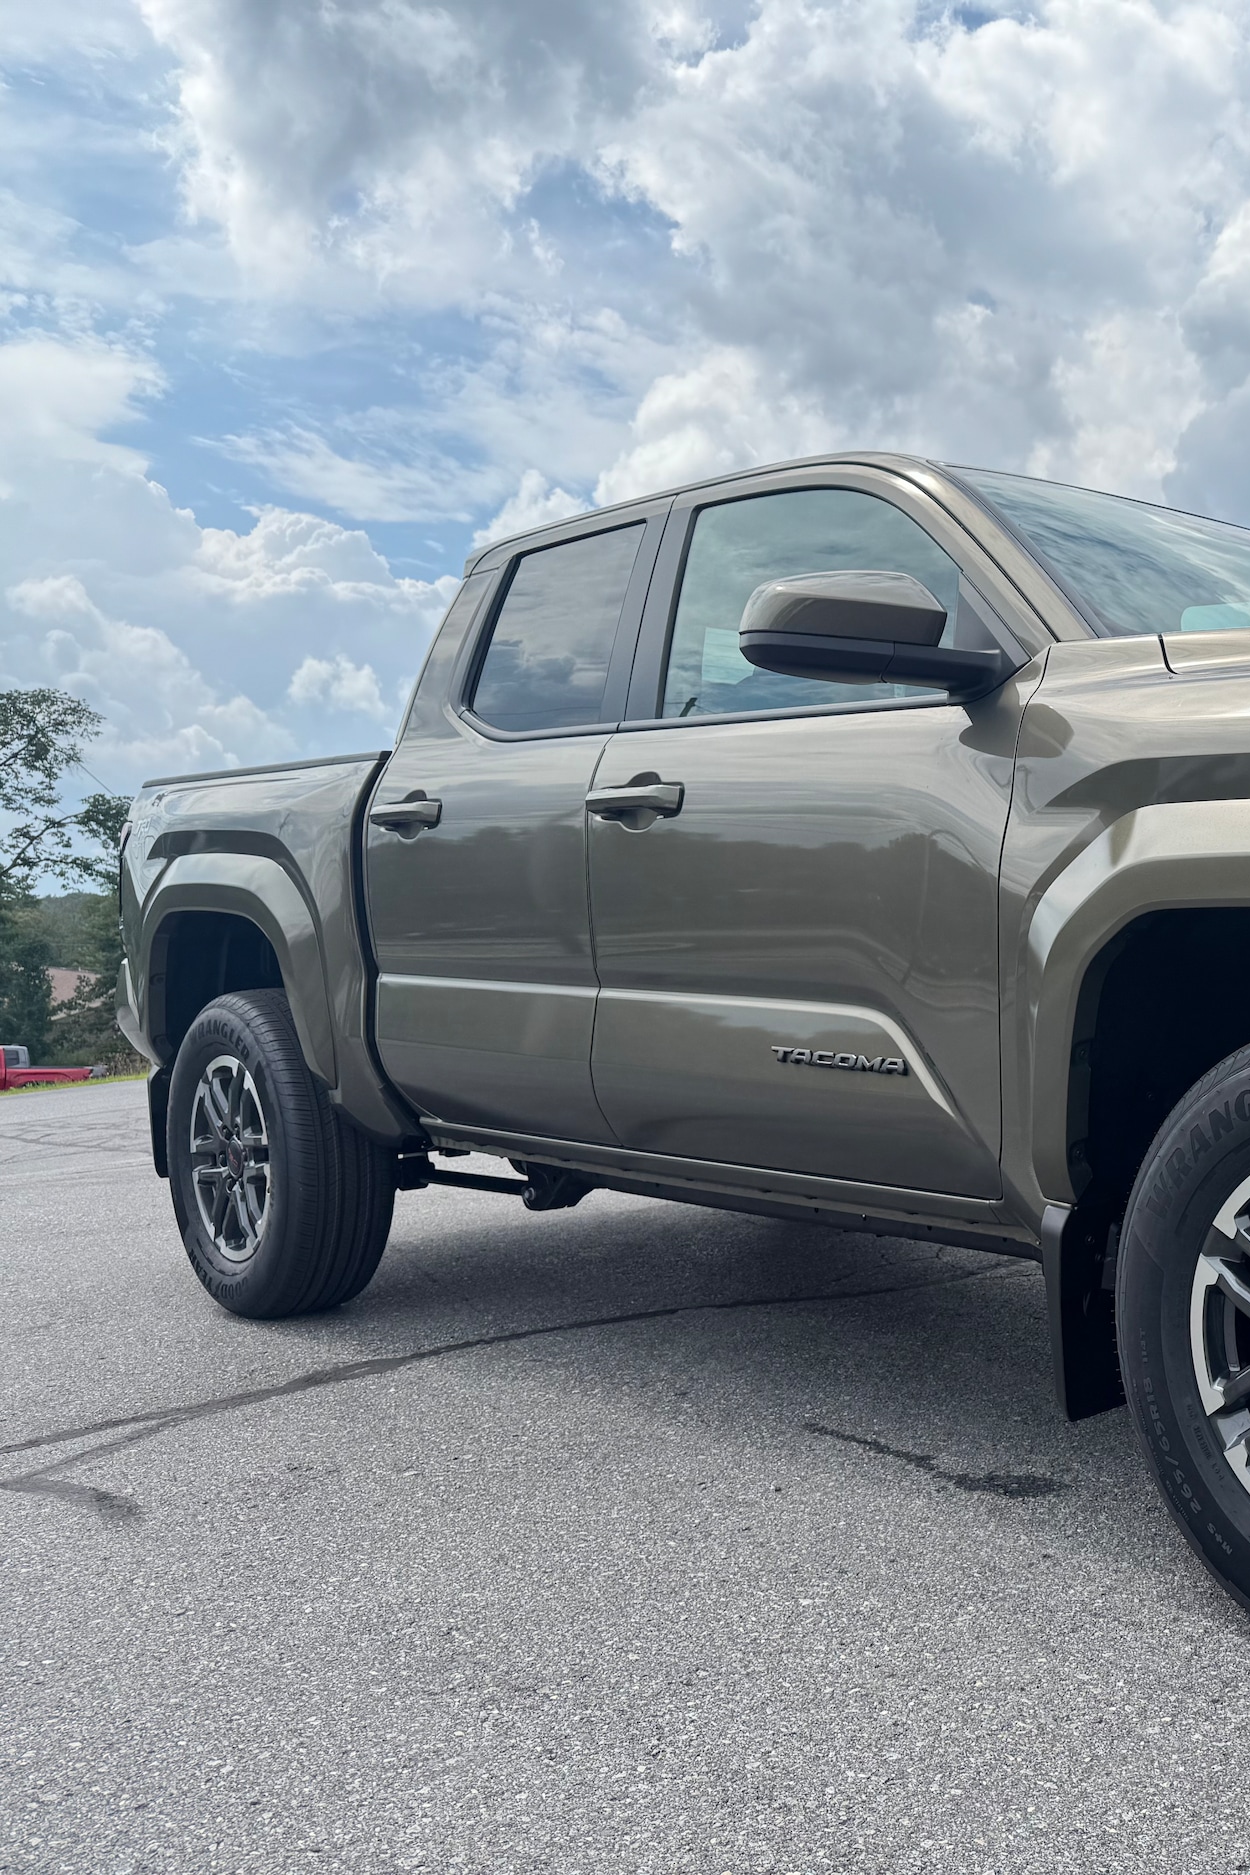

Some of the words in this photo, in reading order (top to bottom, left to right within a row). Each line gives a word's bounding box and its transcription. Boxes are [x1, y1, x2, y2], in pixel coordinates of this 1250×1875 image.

[189, 1019, 250, 1063] WRANGLER
[771, 1045, 909, 1076] TACOMA
[1143, 1377, 1202, 1515] 265/65R18
[1206, 1522, 1233, 1555] M+S
